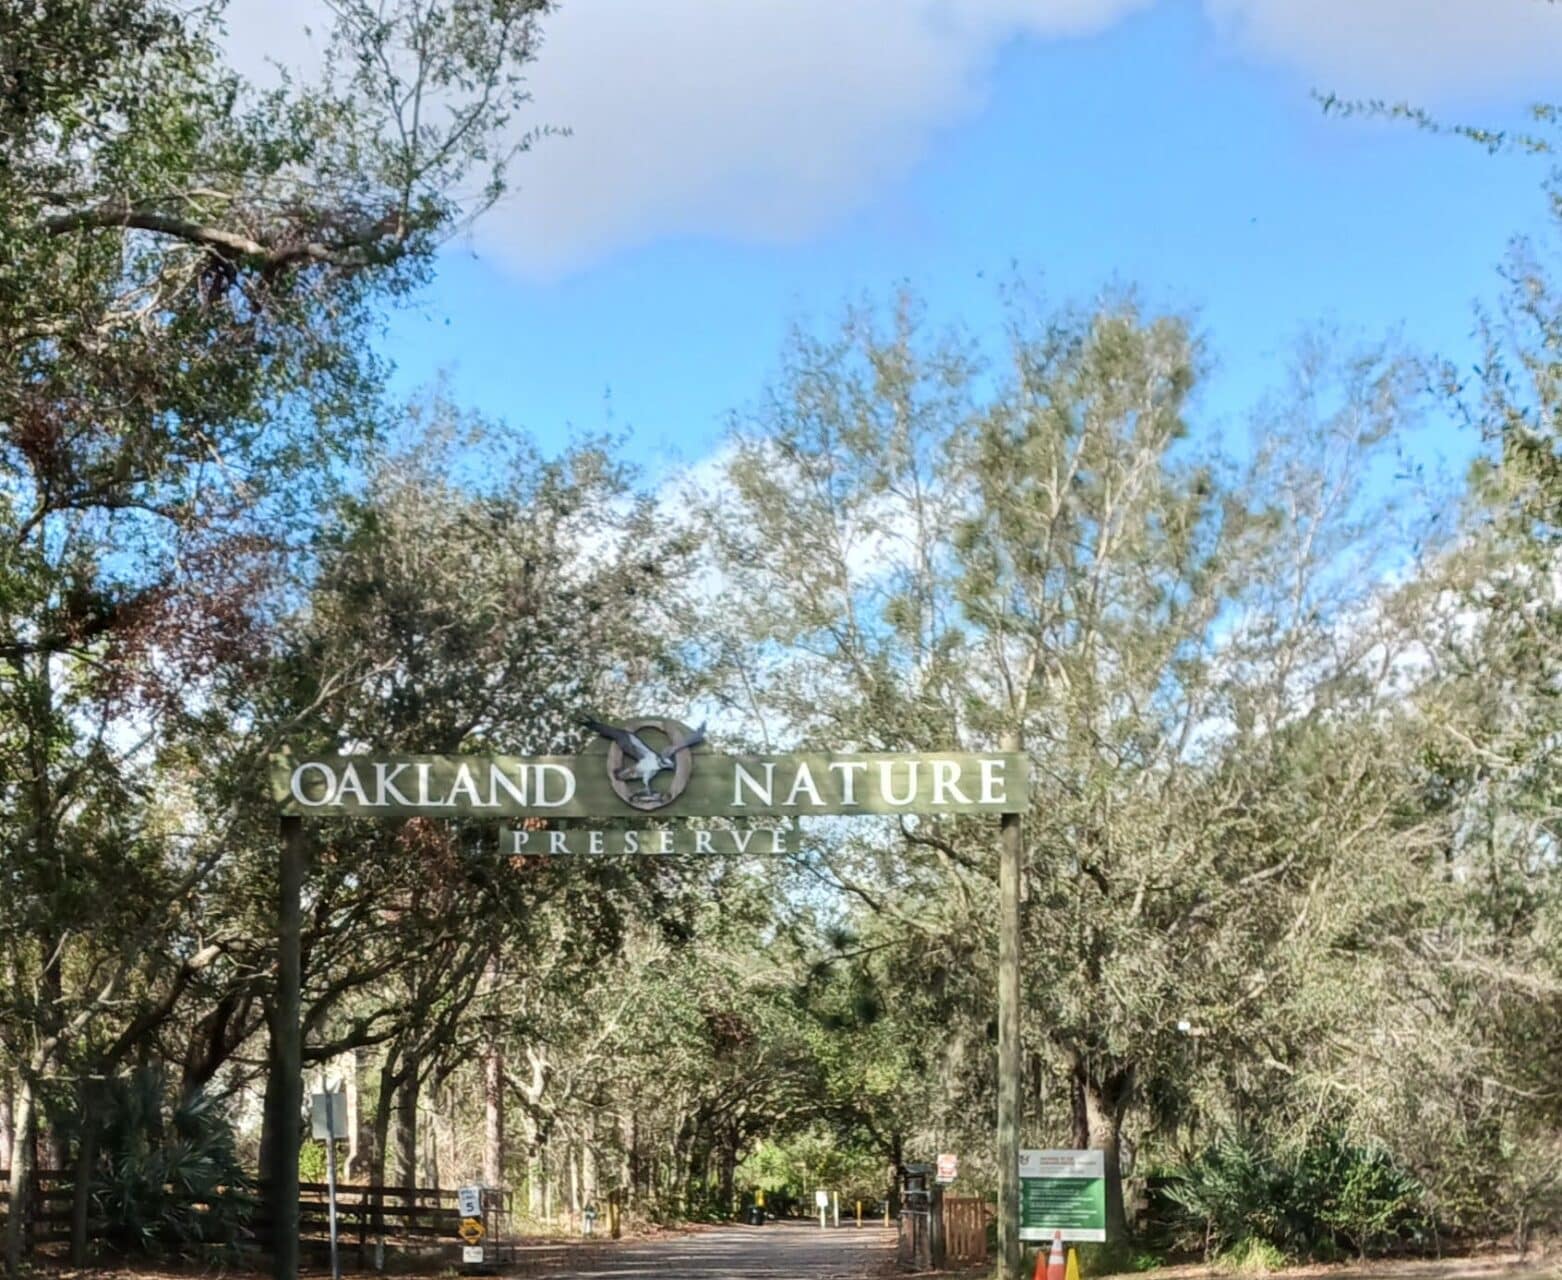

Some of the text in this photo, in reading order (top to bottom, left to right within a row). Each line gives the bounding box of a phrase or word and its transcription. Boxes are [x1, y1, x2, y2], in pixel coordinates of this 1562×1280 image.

[290, 760, 1007, 807] OAKLAND NATURE
[511, 830, 787, 854] PRESERVE
